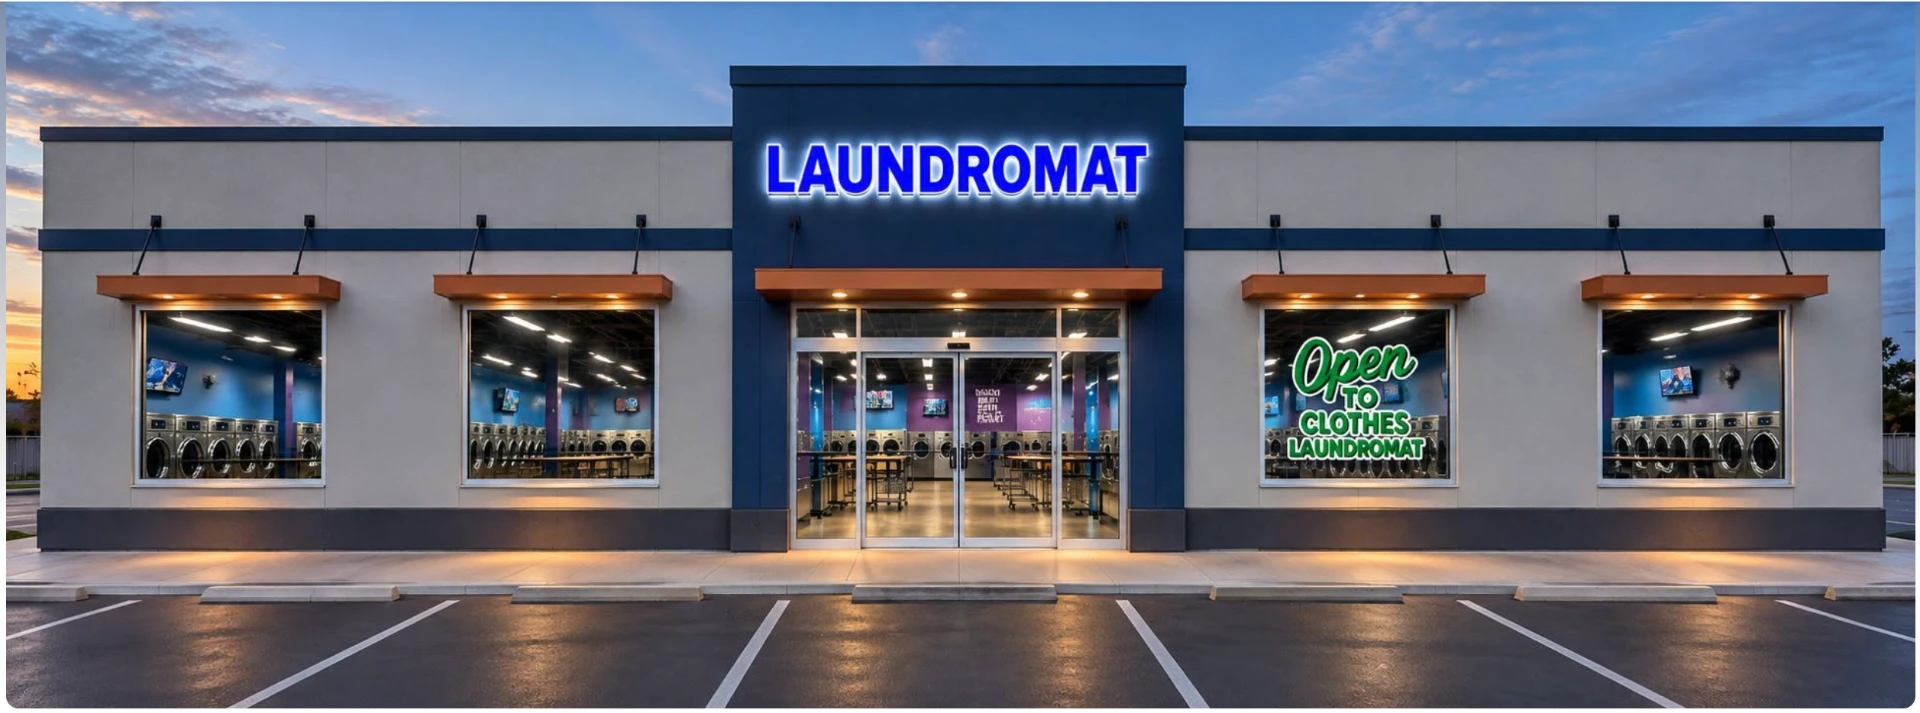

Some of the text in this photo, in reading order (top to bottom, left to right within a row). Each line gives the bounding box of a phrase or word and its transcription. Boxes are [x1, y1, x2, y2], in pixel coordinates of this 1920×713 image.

[766, 143, 1149, 195] LAUNDROMAT
[1293, 337, 1417, 402] Open
[1342, 386, 1379, 409] TO
[1300, 411, 1411, 435] CLOTHES
[1288, 437, 1425, 459] LAUNDROMAT
